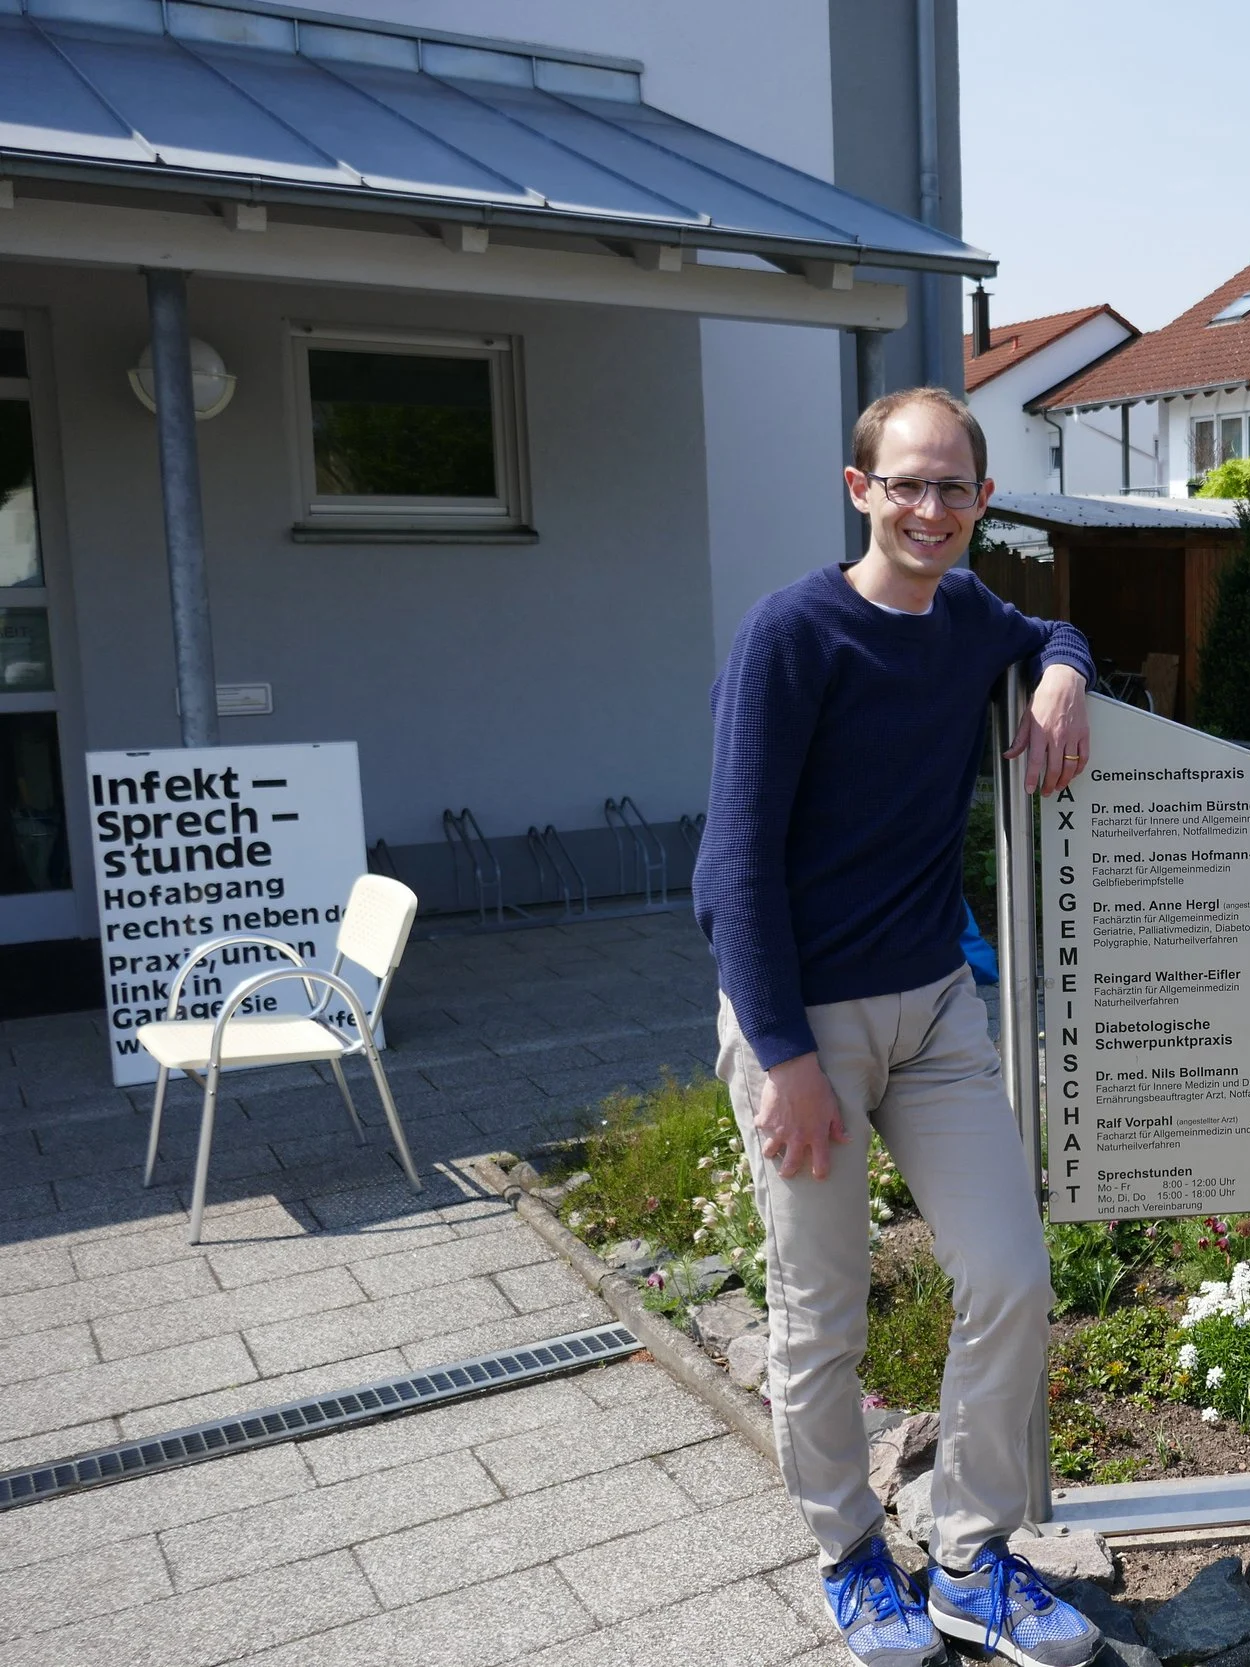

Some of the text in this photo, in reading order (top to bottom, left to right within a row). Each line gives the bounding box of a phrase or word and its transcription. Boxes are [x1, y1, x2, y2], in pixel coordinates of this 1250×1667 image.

[1091, 767, 1244, 782] Gemeinschaftspraxis
[92, 767, 240, 806] Infekt
[1092, 803, 1108, 814] Dr.
[1114, 802, 1144, 814] med.
[1148, 802, 1202, 812] Joachim
[97, 802, 258, 846] Sprech
[1092, 818, 1132, 826] Facharzt
[1135, 817, 1147, 826] für
[1150, 816, 1180, 825] Innere
[1182, 816, 1199, 824] und
[1092, 826, 1248, 838] Naturheilverfahren, Notfallmedizin
[1092, 852, 1110, 863] Dr.
[1114, 852, 1144, 862] med.
[1148, 851, 1187, 862] Jonas
[1092, 864, 1230, 876] Facharzt für Allgemeinmedizin
[1092, 876, 1184, 888] Gelbfieberimpfstelle
[104, 878, 284, 910] Hofabgang
[1094, 902, 1110, 912] Dr.
[1115, 901, 1145, 912] med.
[1149, 900, 1182, 911] Anne
[1186, 899, 1220, 912] Hergl
[106, 914, 213, 942] rechts
[224, 906, 319, 931] neben
[1094, 912, 1239, 925] Fachärztin für Allgemeinmedizin
[1094, 926, 1136, 936] Geriatrie,
[1138, 923, 1212, 935] Palliativmedizin,
[1094, 935, 1238, 948] Polygraphie, Naturheilverfahren
[1094, 969, 1241, 984] Reingard Walther-Eifler
[193, 974, 222, 996] in
[1094, 983, 1240, 996] Fachärztin für Allgemeinmedizin
[1056, 785, 1081, 1203] AXISGEMEINSCHAFT
[1094, 997, 1179, 1007] Naturheilverfahren
[1096, 1019, 1210, 1034] Diabetologische
[1096, 1034, 1232, 1050] Schwerpunktpraxis
[1096, 1066, 1238, 1081] Dr. med. Nils Bollmann
[1096, 1084, 1136, 1093] Facharzt
[1138, 1082, 1150, 1092] für
[1154, 1081, 1182, 1090] Innere
[1185, 1080, 1220, 1090] Medizin
[1222, 1078, 1240, 1088] und
[1096, 1092, 1203, 1104] Ernährungsbeauftragter
[1097, 1116, 1238, 1129] Ralf Vorpahl (angestellter Arzt)
[1097, 1131, 1137, 1141] Facharzt
[1140, 1130, 1151, 1140] für
[1154, 1126, 1232, 1140] Allgemeinmedizin
[1097, 1140, 1180, 1152] Naturheilverfahren
[1098, 1167, 1192, 1182] Sprechstunden
[1098, 1184, 1112, 1192] Mo
[1121, 1183, 1130, 1191] Fr
[1162, 1180, 1182, 1188] 8:00
[1192, 1178, 1216, 1188] 12:00
[1219, 1178, 1236, 1186] Uhr
[1098, 1195, 1114, 1204] Mo,
[1133, 1192, 1146, 1201] Do
[1158, 1192, 1182, 1200] 15:00
[1192, 1190, 1216, 1198] 18:00
[1219, 1188, 1236, 1197] Uhr
[1098, 1201, 1203, 1214] und nach Vereinbarung
